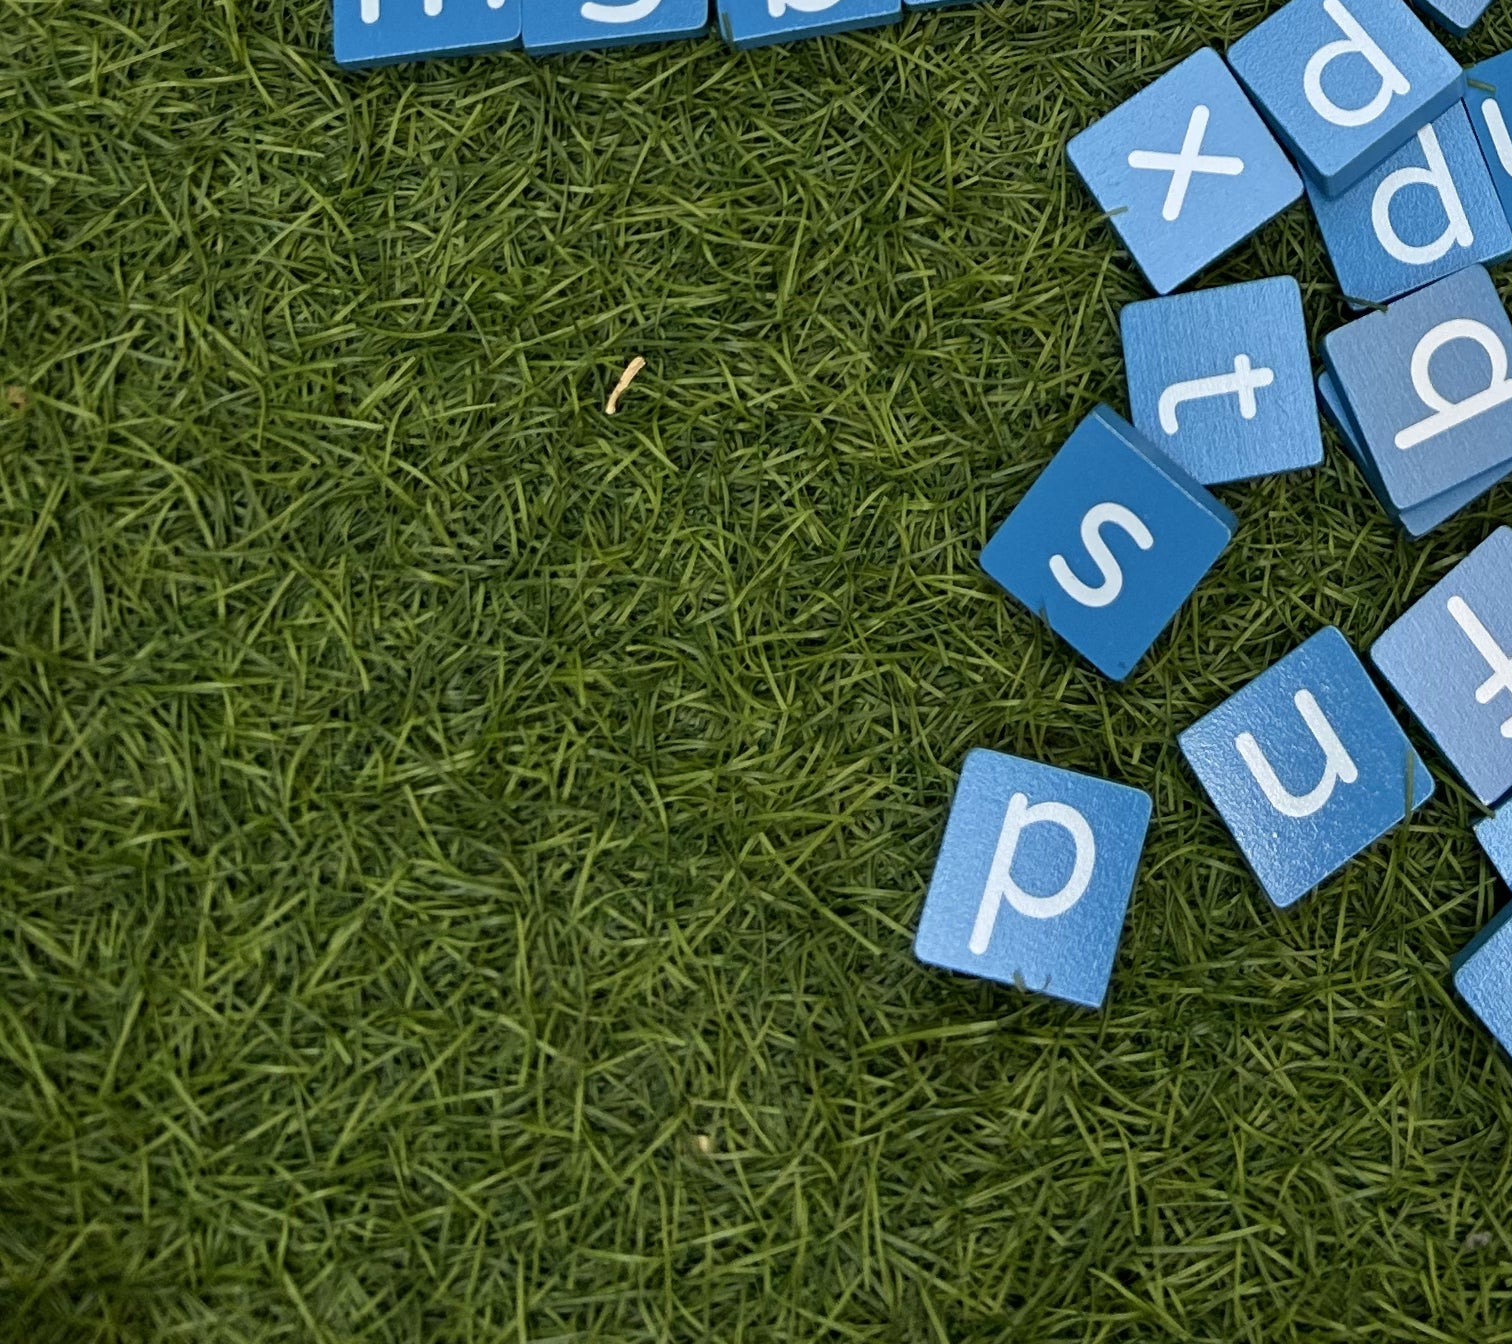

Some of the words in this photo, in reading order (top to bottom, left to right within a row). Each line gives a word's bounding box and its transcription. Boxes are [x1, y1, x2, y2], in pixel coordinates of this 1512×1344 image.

[1127, 104, 1245, 222] x
[1049, 502, 1154, 607] s
[968, 792, 1096, 956] p
